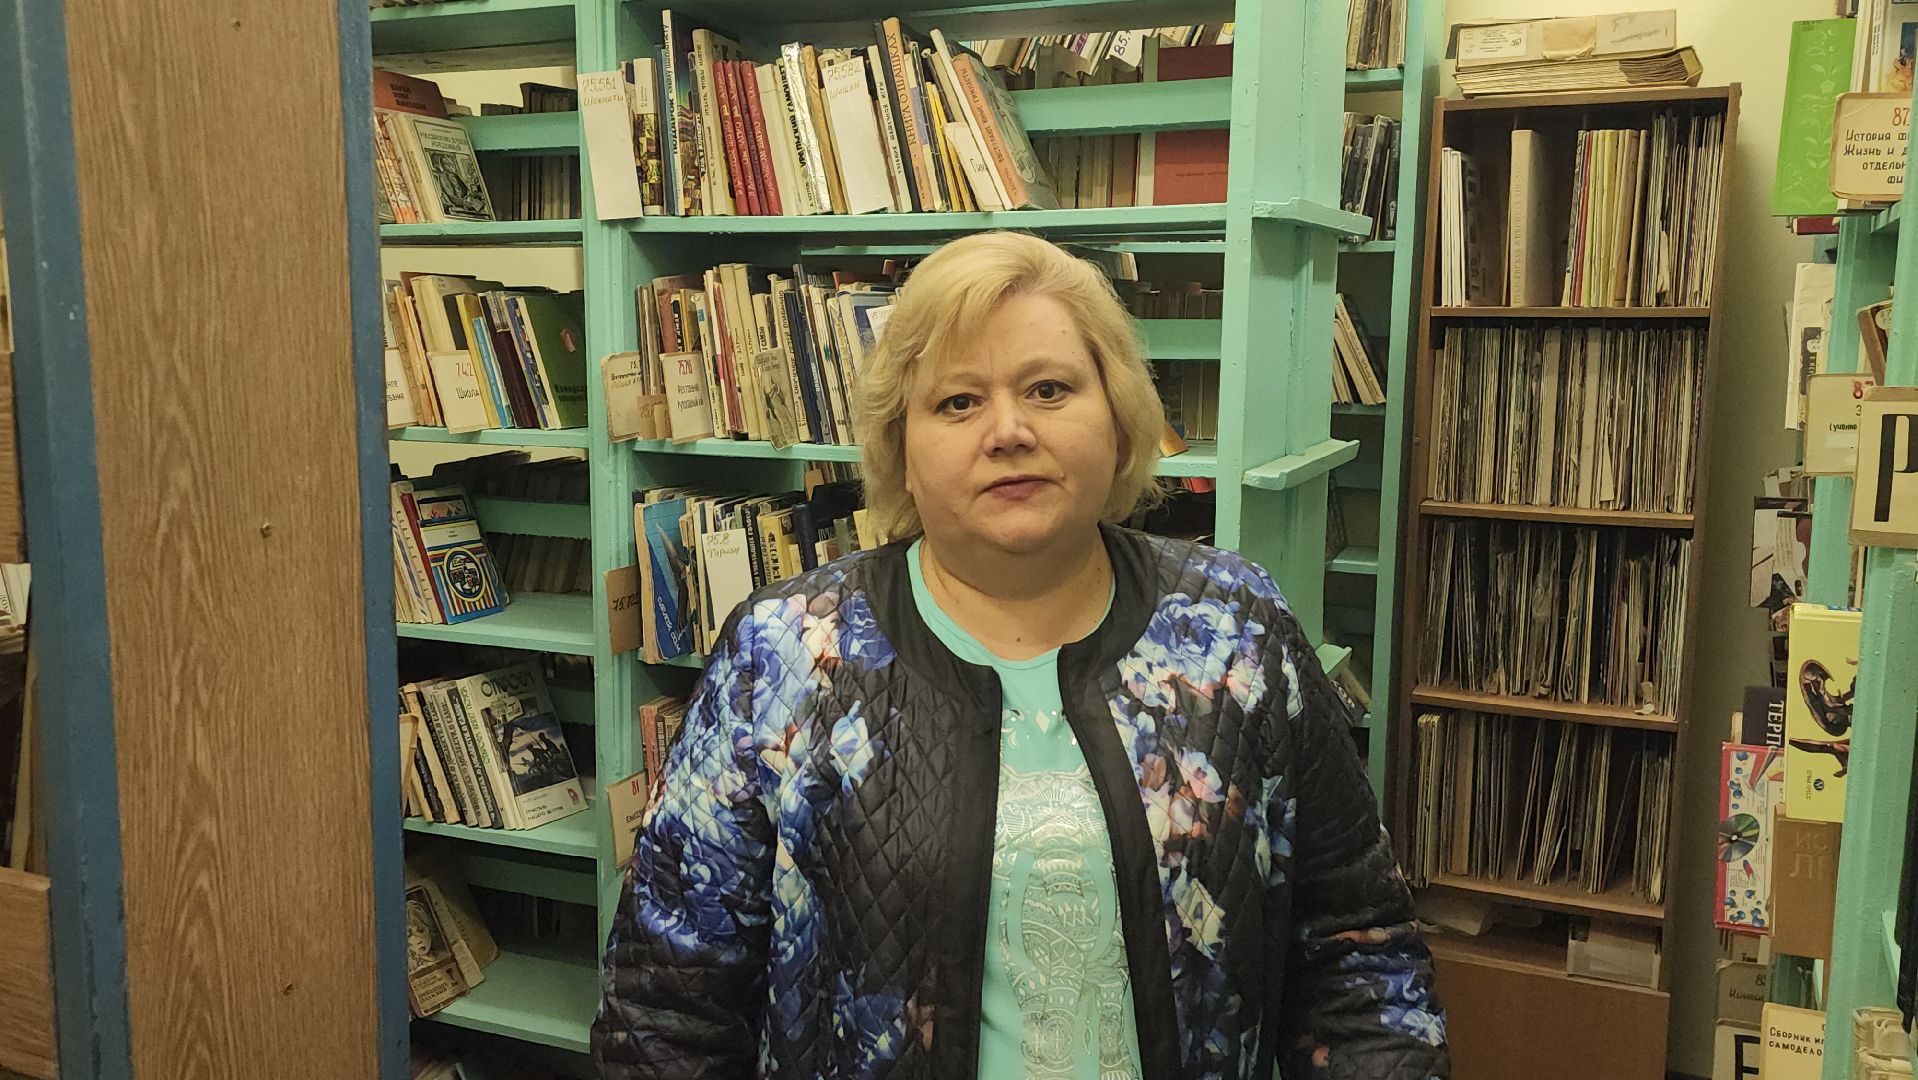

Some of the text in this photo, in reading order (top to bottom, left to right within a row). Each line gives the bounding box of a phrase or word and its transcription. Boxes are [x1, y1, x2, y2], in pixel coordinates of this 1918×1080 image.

[886, 32, 917, 145] КНИГА О ШАШКАХ
[1843, 144, 1882, 156] Жизнь
[1887, 147, 1894, 155] и
[1845, 129, 1891, 142] История
[1766, 700, 1784, 746] ТЕРП
